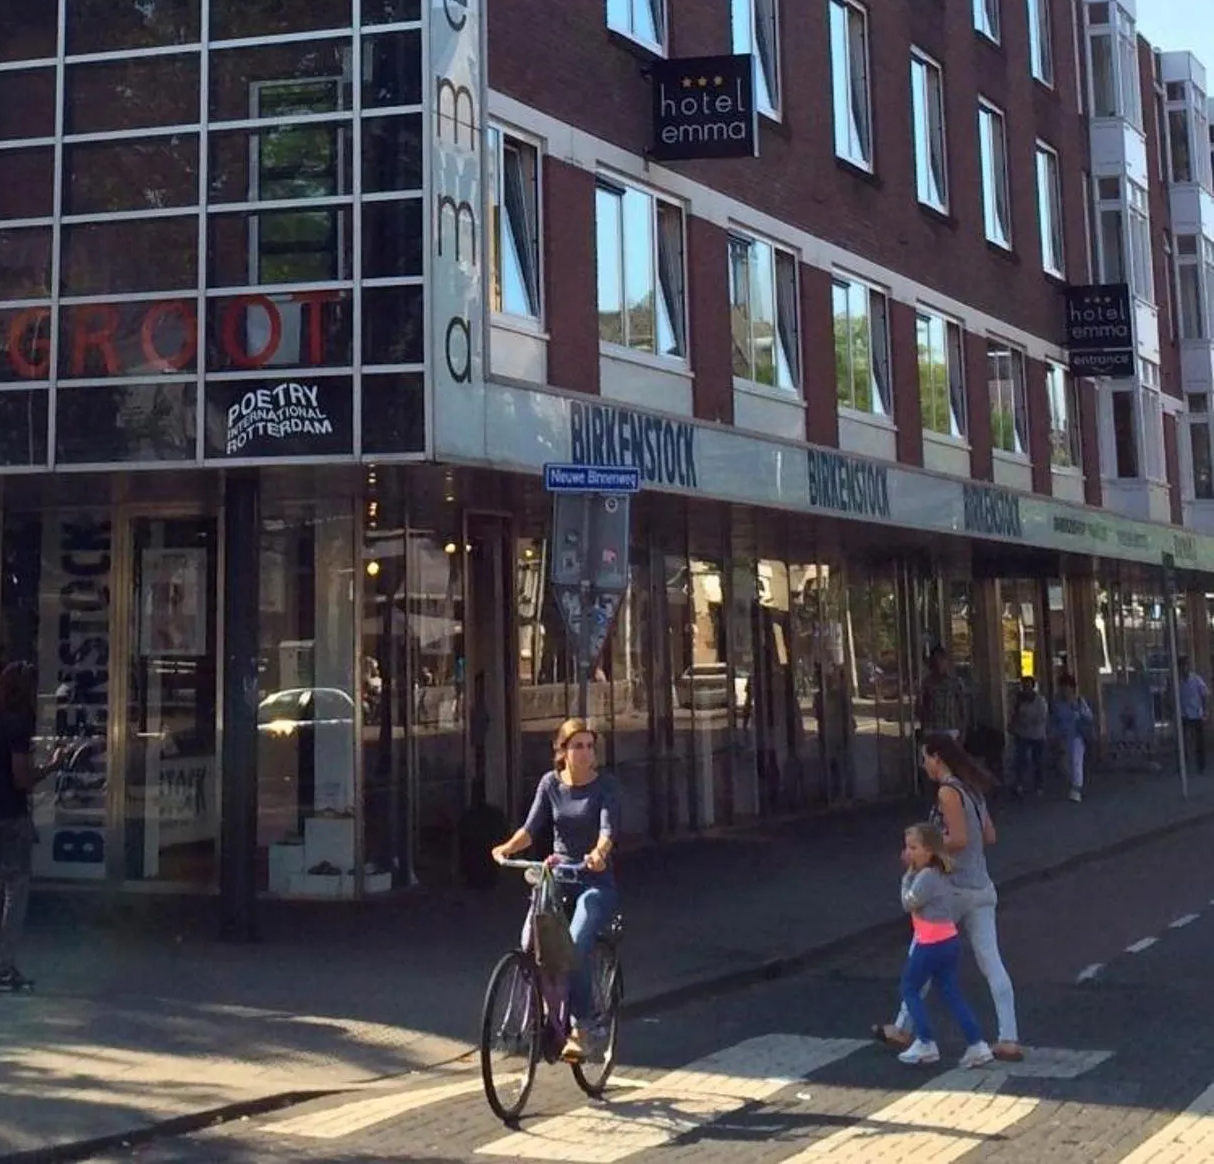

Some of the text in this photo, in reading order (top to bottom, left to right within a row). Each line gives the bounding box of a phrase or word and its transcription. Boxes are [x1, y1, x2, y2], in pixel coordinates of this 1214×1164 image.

[659, 76, 746, 117] hotel
[660, 120, 746, 144] emma
[1069, 297, 1126, 322] hotel
[8, 289, 347, 378] GROOT
[1072, 324, 1128, 339] emma
[226, 383, 319, 428] POETRY
[226, 405, 328, 440] INTERNATIONAL
[224, 419, 334, 455] ROTTERDAM
[571, 402, 698, 488] BIRKENSTOCK
[550, 468, 585, 485] Nieuwe
